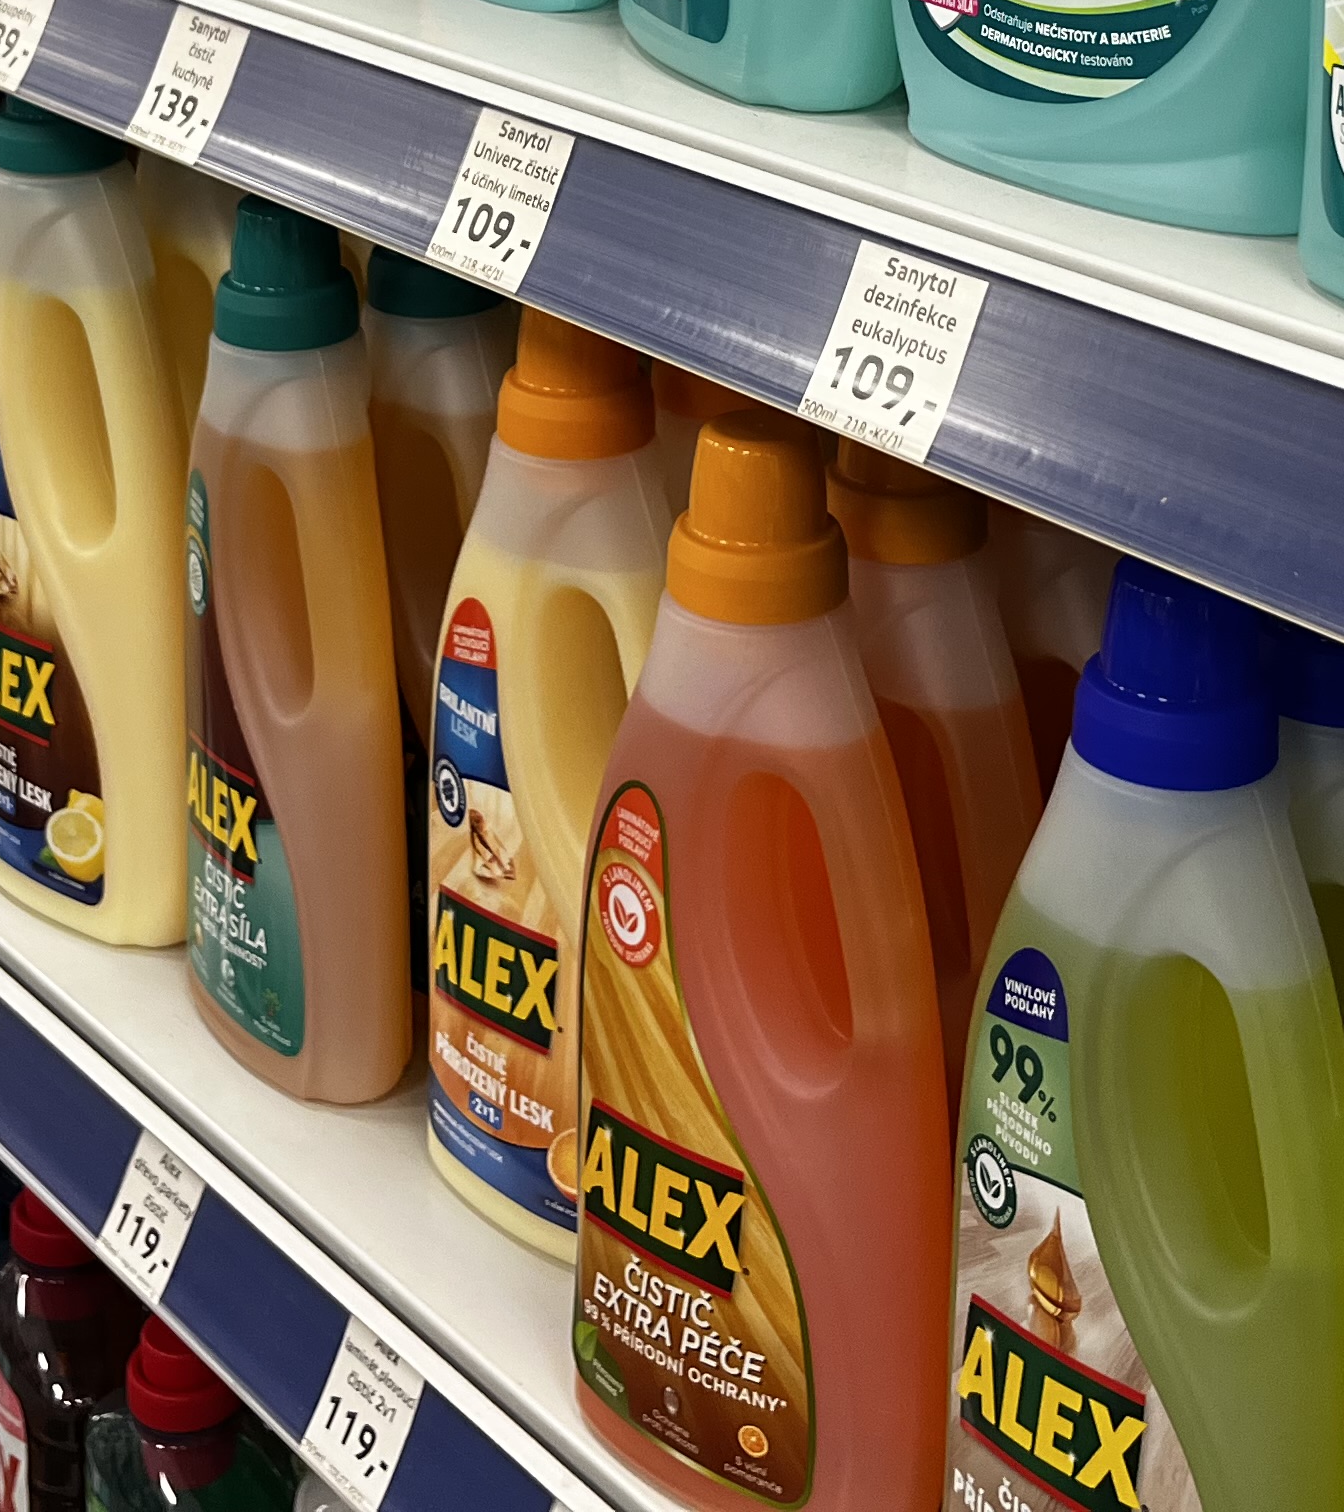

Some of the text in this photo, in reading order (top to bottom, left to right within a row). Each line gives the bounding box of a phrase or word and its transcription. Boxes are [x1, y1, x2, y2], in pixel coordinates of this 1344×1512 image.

[189, 16, 231, 44] Sanytol
[981, 24, 1134, 68] DERMATOLOGICKY testováno
[983, 3, 1171, 46] Odstraňuje NEČISTOTY BAKTERIE
[171, 61, 214, 91] kuchyně
[188, 42, 216, 65] čistič
[149, 84, 209, 138] 139,-
[499, 120, 553, 154] Sanytol
[471, 170, 507, 199] účinky
[509, 186, 550, 213] limetka
[452, 196, 531, 262] 109,-
[884, 257, 957, 298] Sanytol
[864, 285, 957, 332] dezinfekce
[852, 318, 948, 365] eukalyptus
[830, 346, 937, 427] 109,-
[804, 398, 838, 423] 500ml
[19, 776, 54, 813] LESK
[187, 751, 258, 863] ALEX
[204, 854, 246, 910] ČISTIČ
[229, 912, 269, 956] SÍLA
[434, 908, 560, 1032] ALEX
[1004, 976, 1057, 1007] VINYLOVÉ
[1004, 993, 1055, 1021] PODLAHY
[466, 1030, 508, 1077] ČISTIČ
[989, 1024, 1057, 1124] 99%
[509, 1088, 555, 1134] LESK
[998, 1090, 1040, 1132] SLOŽEK
[994, 1124, 1040, 1167] PŮVODU
[581, 1125, 746, 1273] ALEX
[116, 1202, 170, 1274] 119,-
[623, 1253, 713, 1329] ČISTIČ
[593, 1271, 766, 1385] EXTRA PÉČE
[613, 1322, 685, 1377] PŘÍRODNÍ
[324, 1395, 389, 1478] 119,-
[959, 1325, 1149, 1510] ALEX
